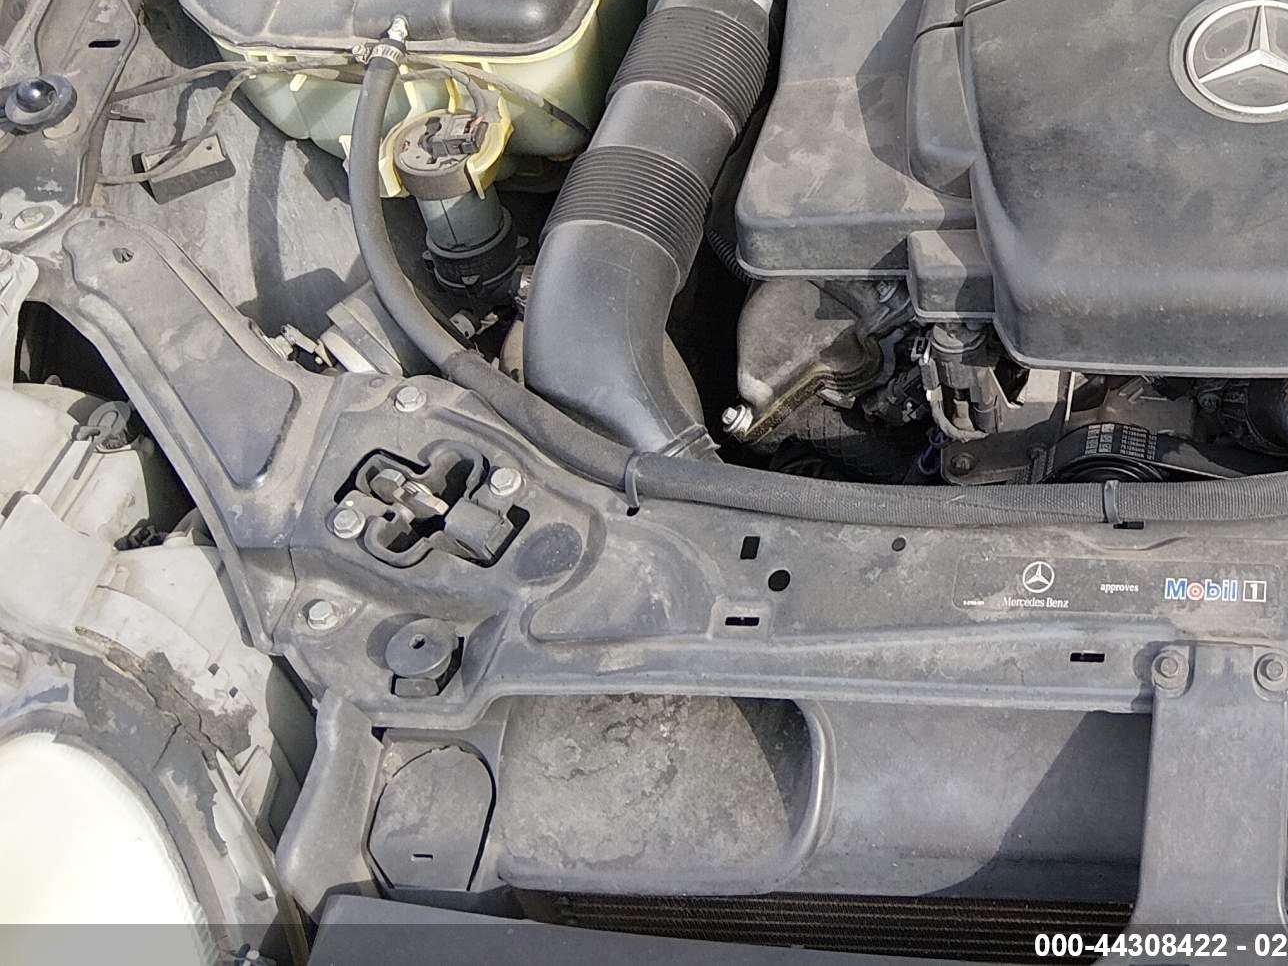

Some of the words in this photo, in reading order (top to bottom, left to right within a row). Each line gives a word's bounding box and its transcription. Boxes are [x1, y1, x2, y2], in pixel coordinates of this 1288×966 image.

[1100, 583, 1139, 594] approves
[1164, 577, 1239, 602] Mobil
[1002, 596, 1045, 608] Mercedes
[1046, 597, 1069, 608] Benz
